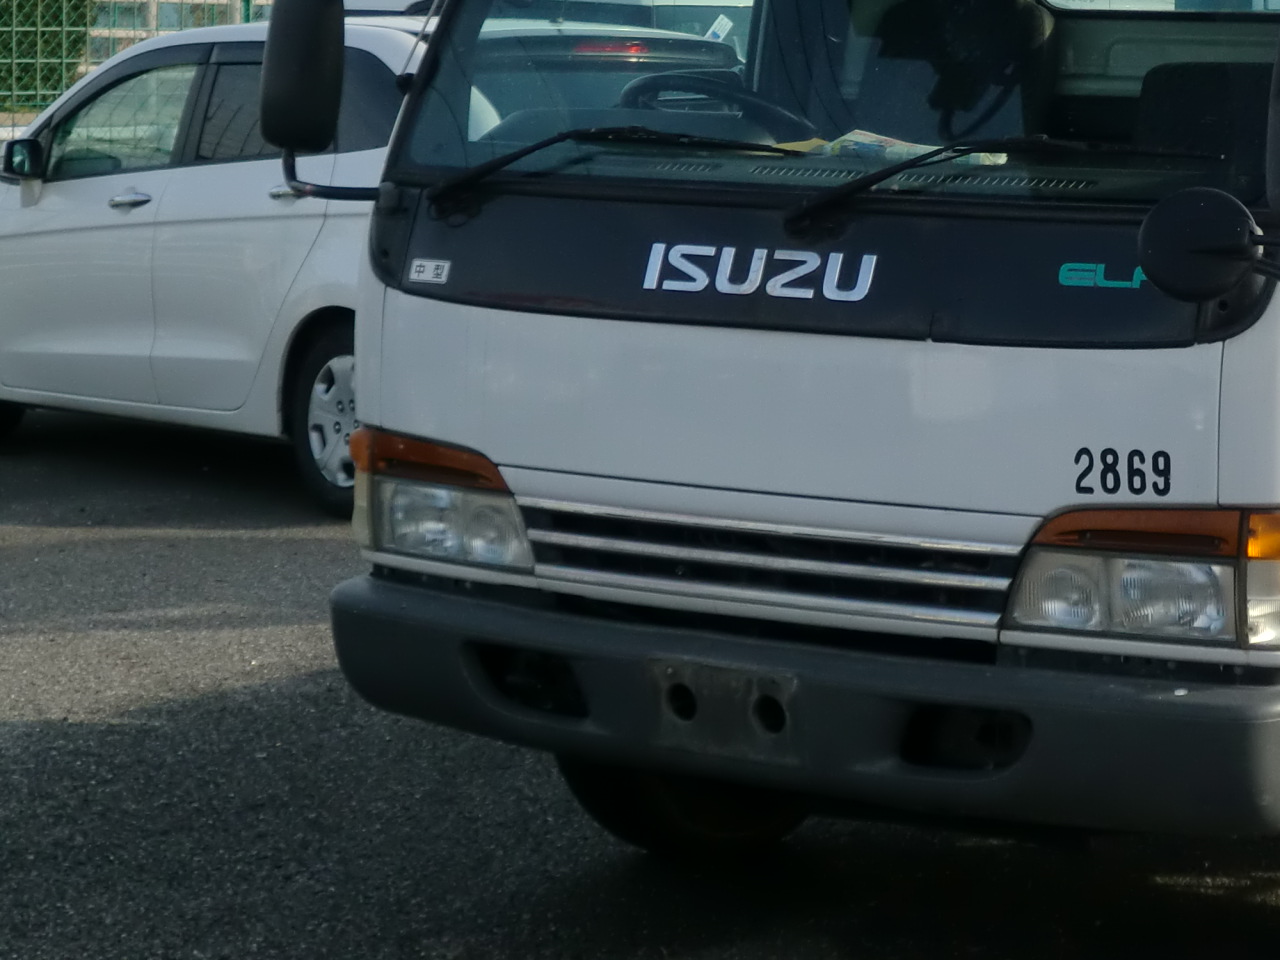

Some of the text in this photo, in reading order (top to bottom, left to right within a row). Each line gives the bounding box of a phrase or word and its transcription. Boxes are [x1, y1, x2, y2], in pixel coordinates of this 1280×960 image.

[415, 263, 445, 279] 中型
[643, 242, 877, 302] ISUZU
[1074, 447, 1171, 496] 2869
